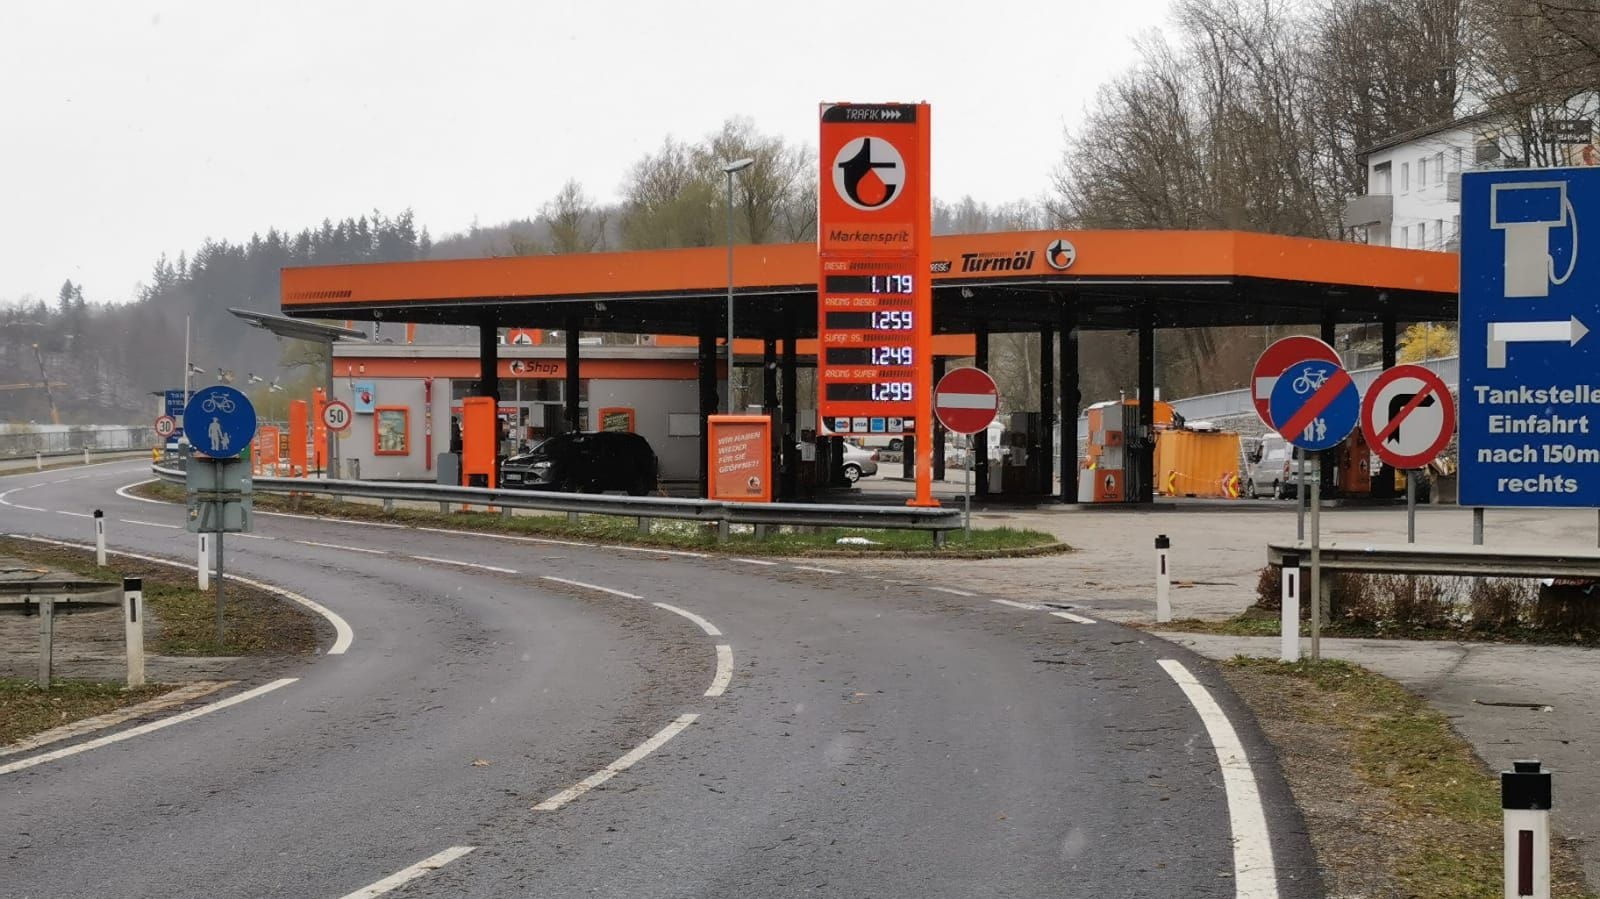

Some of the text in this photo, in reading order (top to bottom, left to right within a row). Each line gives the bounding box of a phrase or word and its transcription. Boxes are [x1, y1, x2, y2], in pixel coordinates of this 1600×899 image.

[846, 109, 879, 120] TRAFIK
[829, 230, 909, 244] Markensprit
[824, 262, 847, 270] DIESEL
[872, 275, 912, 293] 1.179
[825, 298, 878, 306] RACING DIESEL
[872, 311, 912, 329] 1.259
[824, 334, 848, 342] SUPER
[872, 346, 912, 364] 1.249
[526, 361, 559, 374] Shop
[825, 370, 878, 378] RACING SUPER
[872, 382, 912, 400] 1.299
[1473, 384, 1600, 404] Tankstelle
[329, 409, 344, 423] 50
[160, 421, 171, 433] 30
[1488, 415, 1589, 433] Einfahrt
[719, 431, 760, 445] WIR HABEN
[1478, 444, 1538, 463] nach
[1498, 474, 1578, 492] rechts
